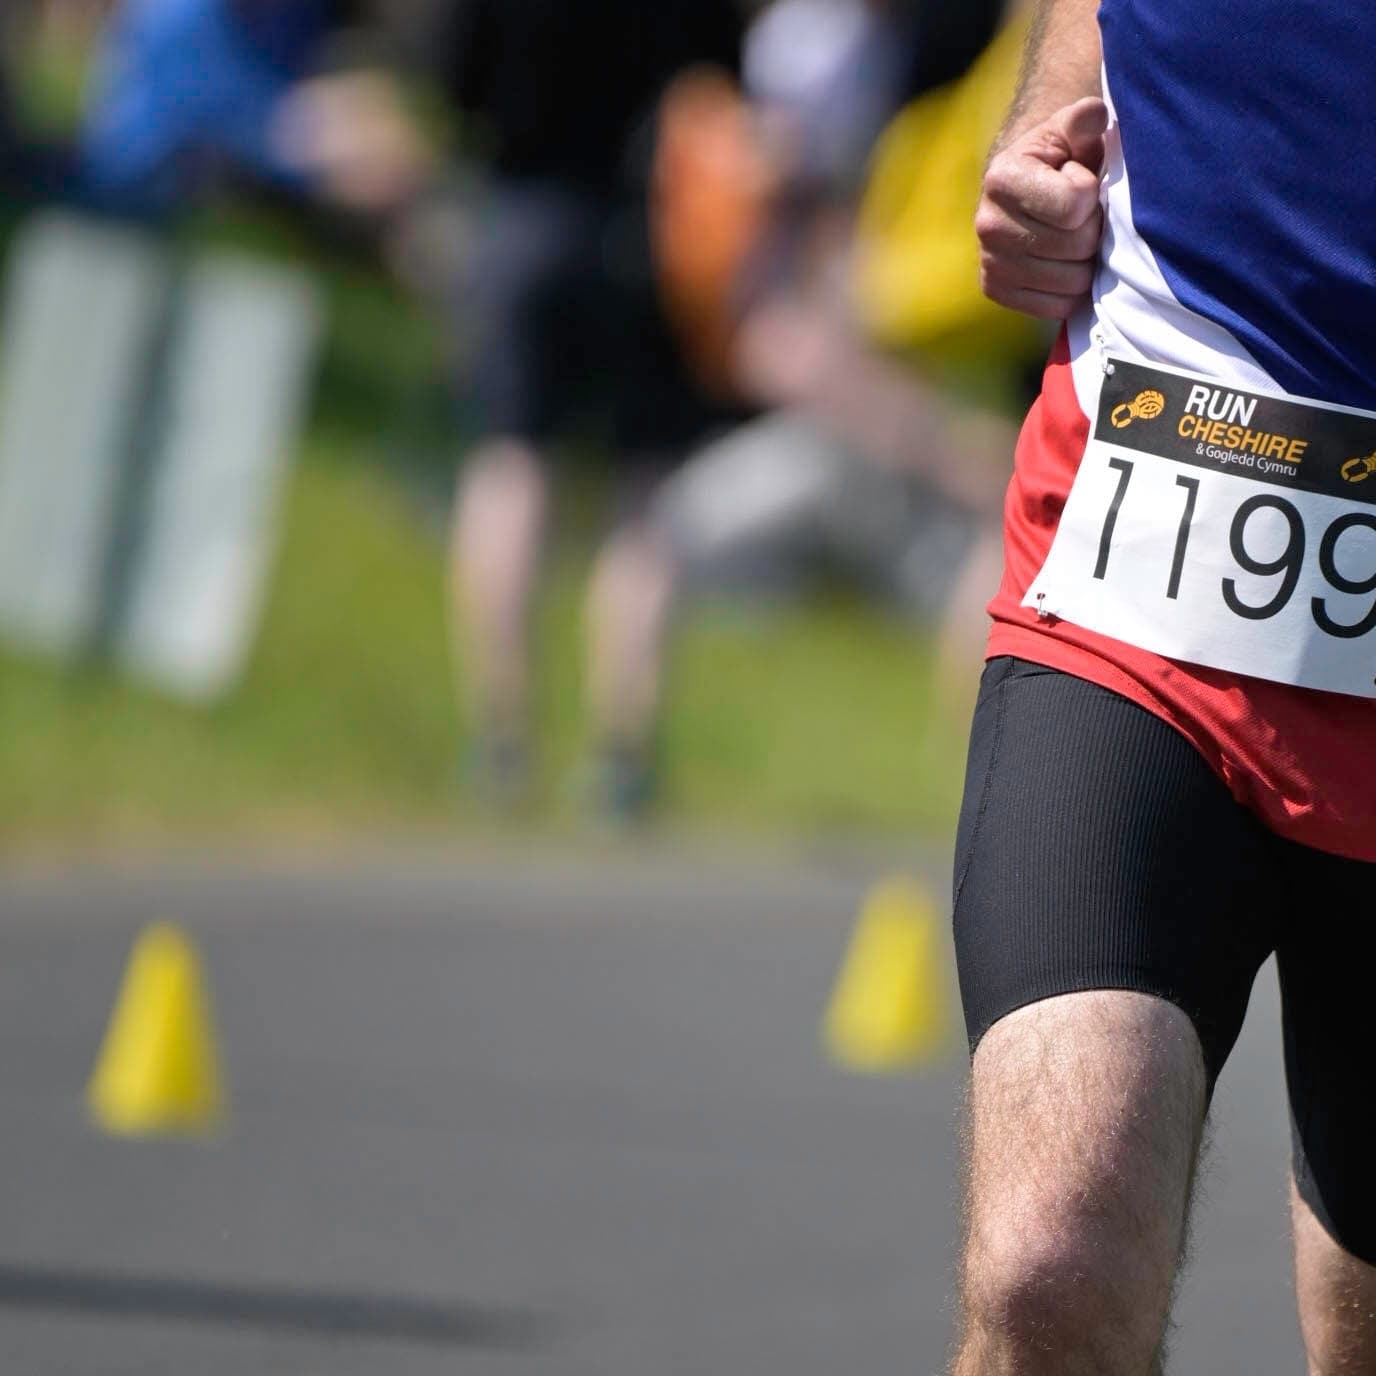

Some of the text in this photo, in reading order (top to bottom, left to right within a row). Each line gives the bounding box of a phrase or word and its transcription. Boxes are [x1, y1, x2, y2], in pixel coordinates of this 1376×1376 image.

[1184, 384, 1258, 427] RUN
[1178, 415, 1308, 463] CHESHIRE
[1196, 442, 1297, 476] & Gogledd Cymru
